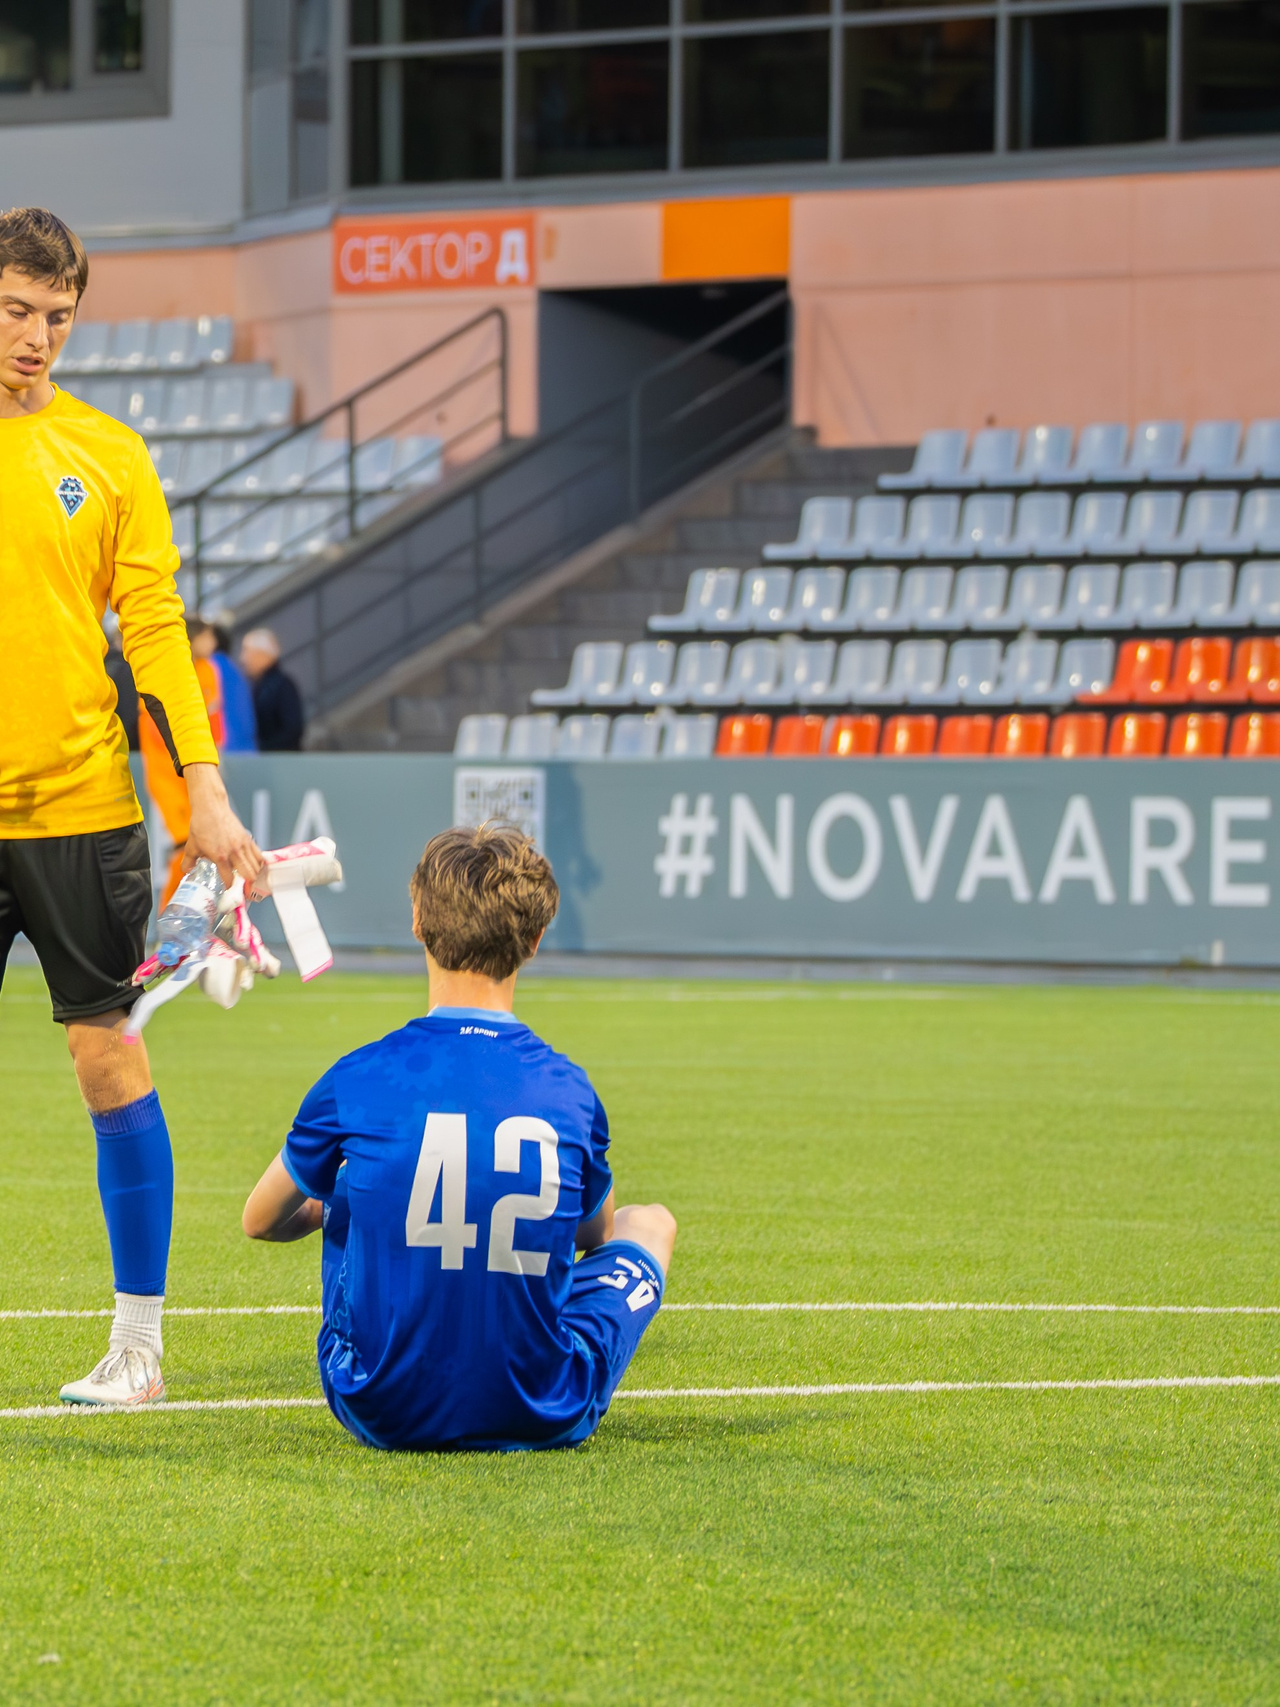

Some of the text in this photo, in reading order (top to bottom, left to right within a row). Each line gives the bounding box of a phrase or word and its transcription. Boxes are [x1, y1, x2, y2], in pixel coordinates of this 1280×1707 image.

[340, 228, 529, 285] СЕКТОР Д
[654, 792, 1271, 906] #NOVAARE
[405, 1112, 559, 1277] 42
